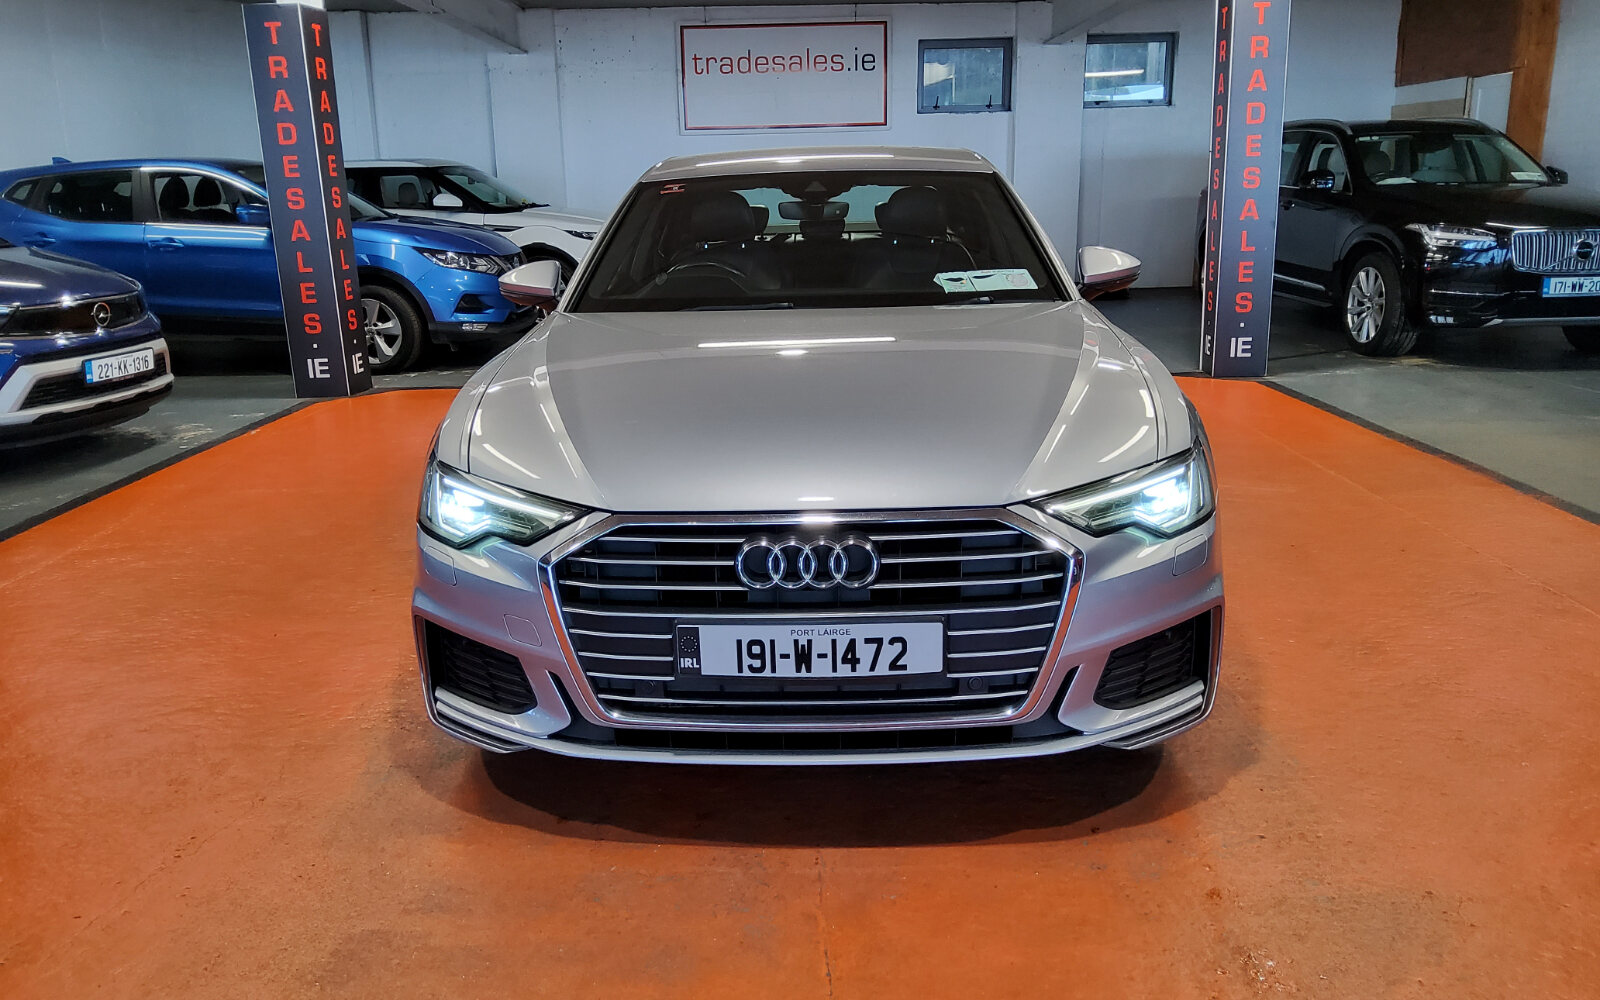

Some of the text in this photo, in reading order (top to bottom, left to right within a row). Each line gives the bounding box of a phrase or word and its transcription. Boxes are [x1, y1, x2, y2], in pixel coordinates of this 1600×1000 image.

[692, 47, 876, 75] tradesales.ie
[97, 355, 149, 379] 221-KK-1316
[790, 629, 815, 637] PORT
[680, 658, 700, 669] IRL
[736, 636, 908, 674] 191-W-1472
